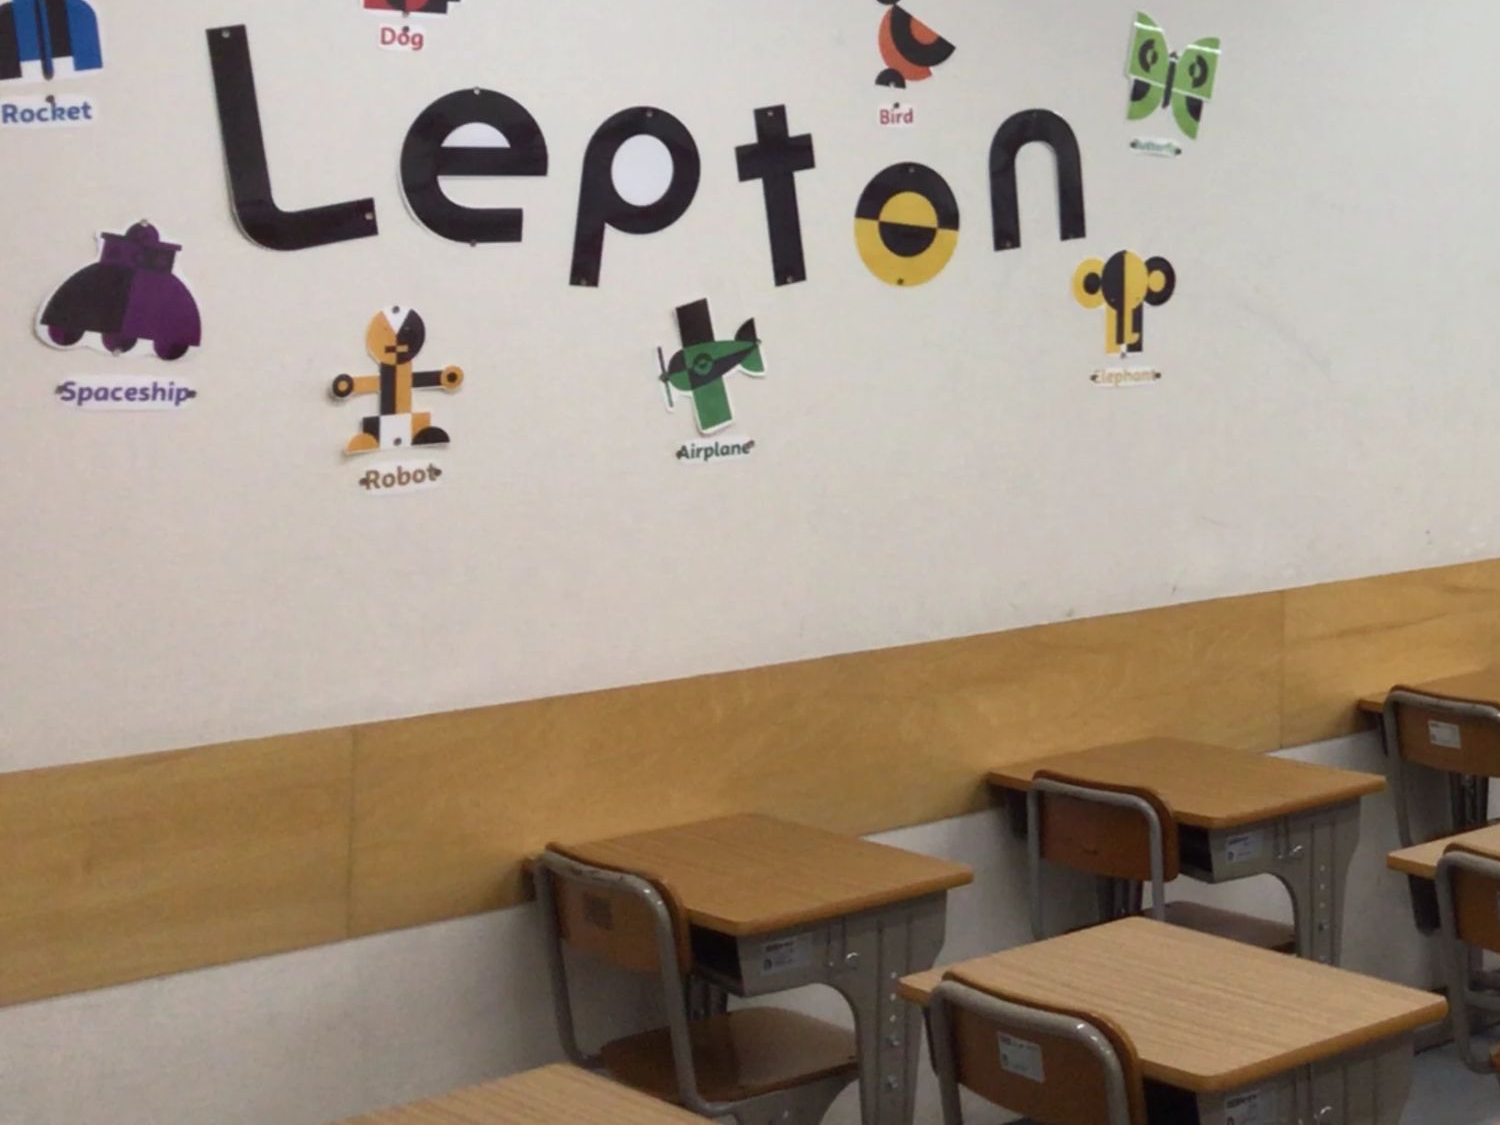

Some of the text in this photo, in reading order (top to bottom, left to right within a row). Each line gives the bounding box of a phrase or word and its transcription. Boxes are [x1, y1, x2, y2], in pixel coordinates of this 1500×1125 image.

[380, 26, 424, 51] Dog
[1, 101, 93, 124] Rocket
[880, 107, 914, 125] Bird
[205, 24, 1086, 288] Lepton
[60, 381, 190, 406] Spaceship
[680, 441, 751, 461] Airplane
[365, 463, 440, 490] Robot
